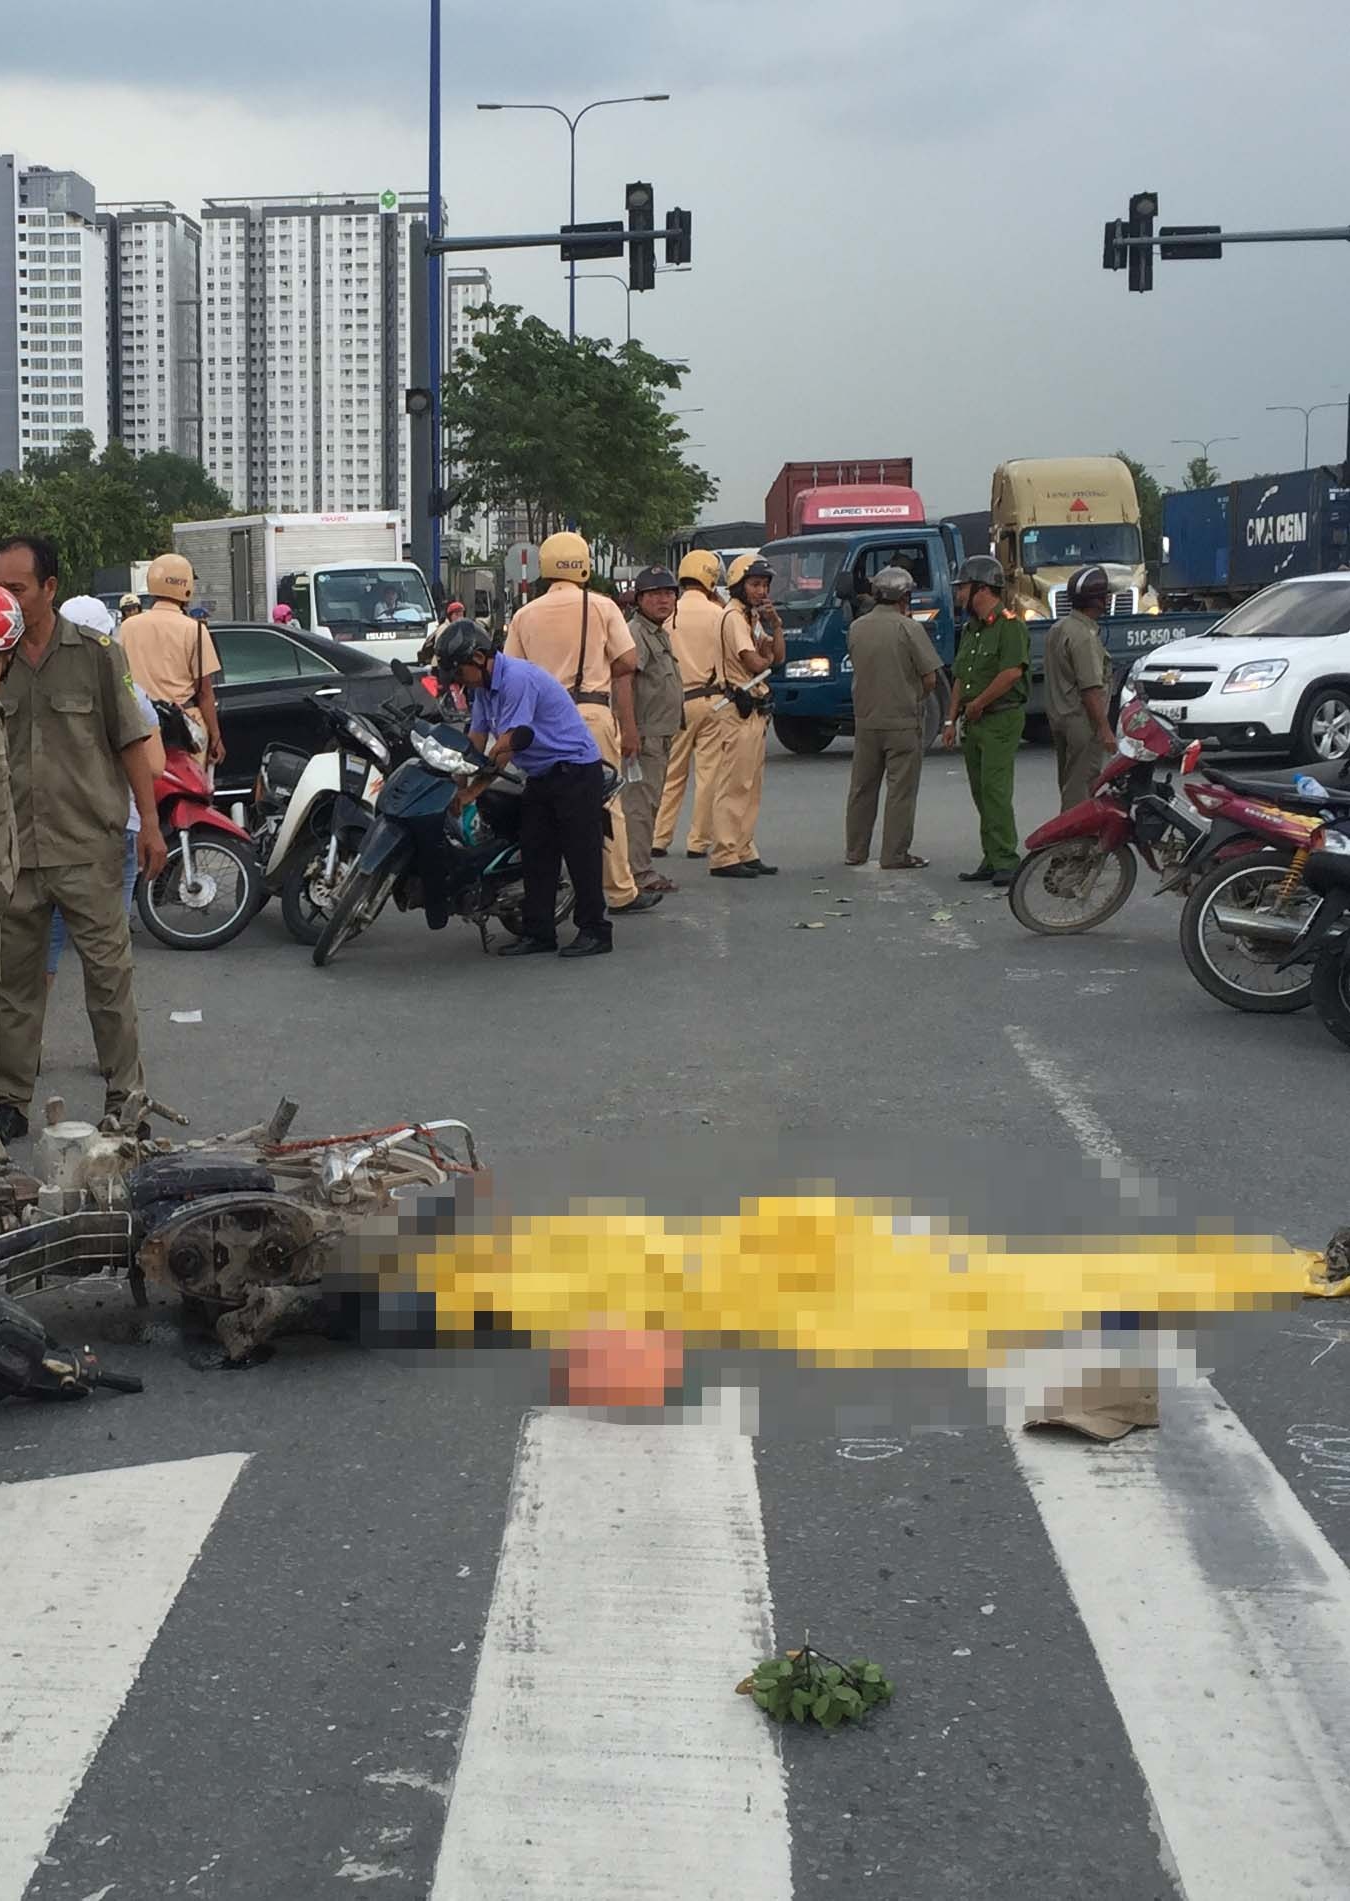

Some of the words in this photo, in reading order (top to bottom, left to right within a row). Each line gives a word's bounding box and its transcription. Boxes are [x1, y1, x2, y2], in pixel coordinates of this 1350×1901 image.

[833, 507, 863, 516] APEC
[865, 505, 902, 514] TRANS
[366, 631, 396, 640] ISUZU
